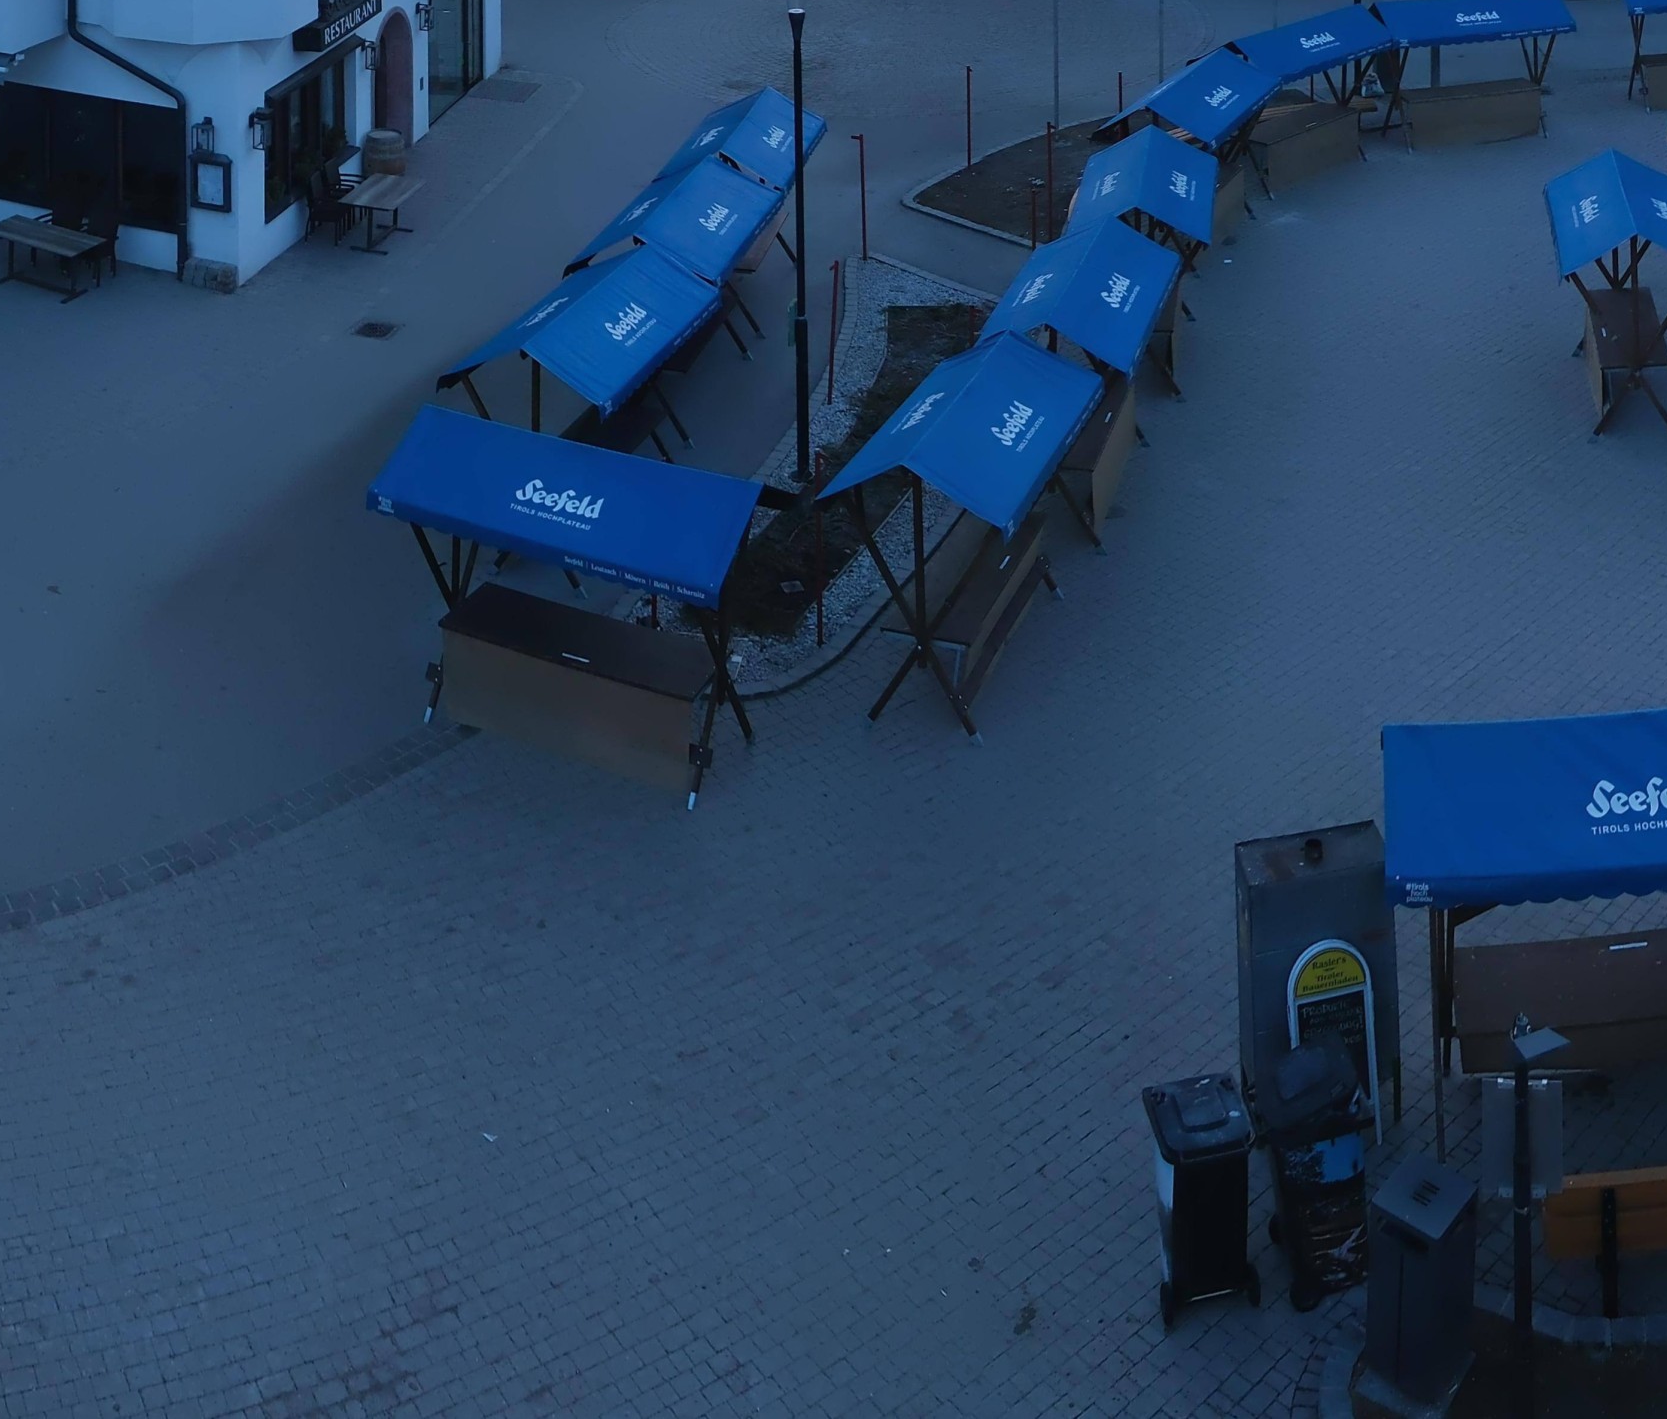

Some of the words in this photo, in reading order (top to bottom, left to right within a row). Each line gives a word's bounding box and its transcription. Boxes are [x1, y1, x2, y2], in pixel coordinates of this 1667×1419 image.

[1455, 10, 1500, 22] Seefeld
[1100, 272, 1130, 308] Seefeld
[604, 302, 648, 341] Seefeld
[991, 400, 1033, 446] Seefeld
[510, 503, 535, 515] TIROLS
[537, 510, 591, 530] HOCHPLATEAU
[516, 479, 605, 518] Seefeld
[1591, 824, 1630, 835] TIROLS
